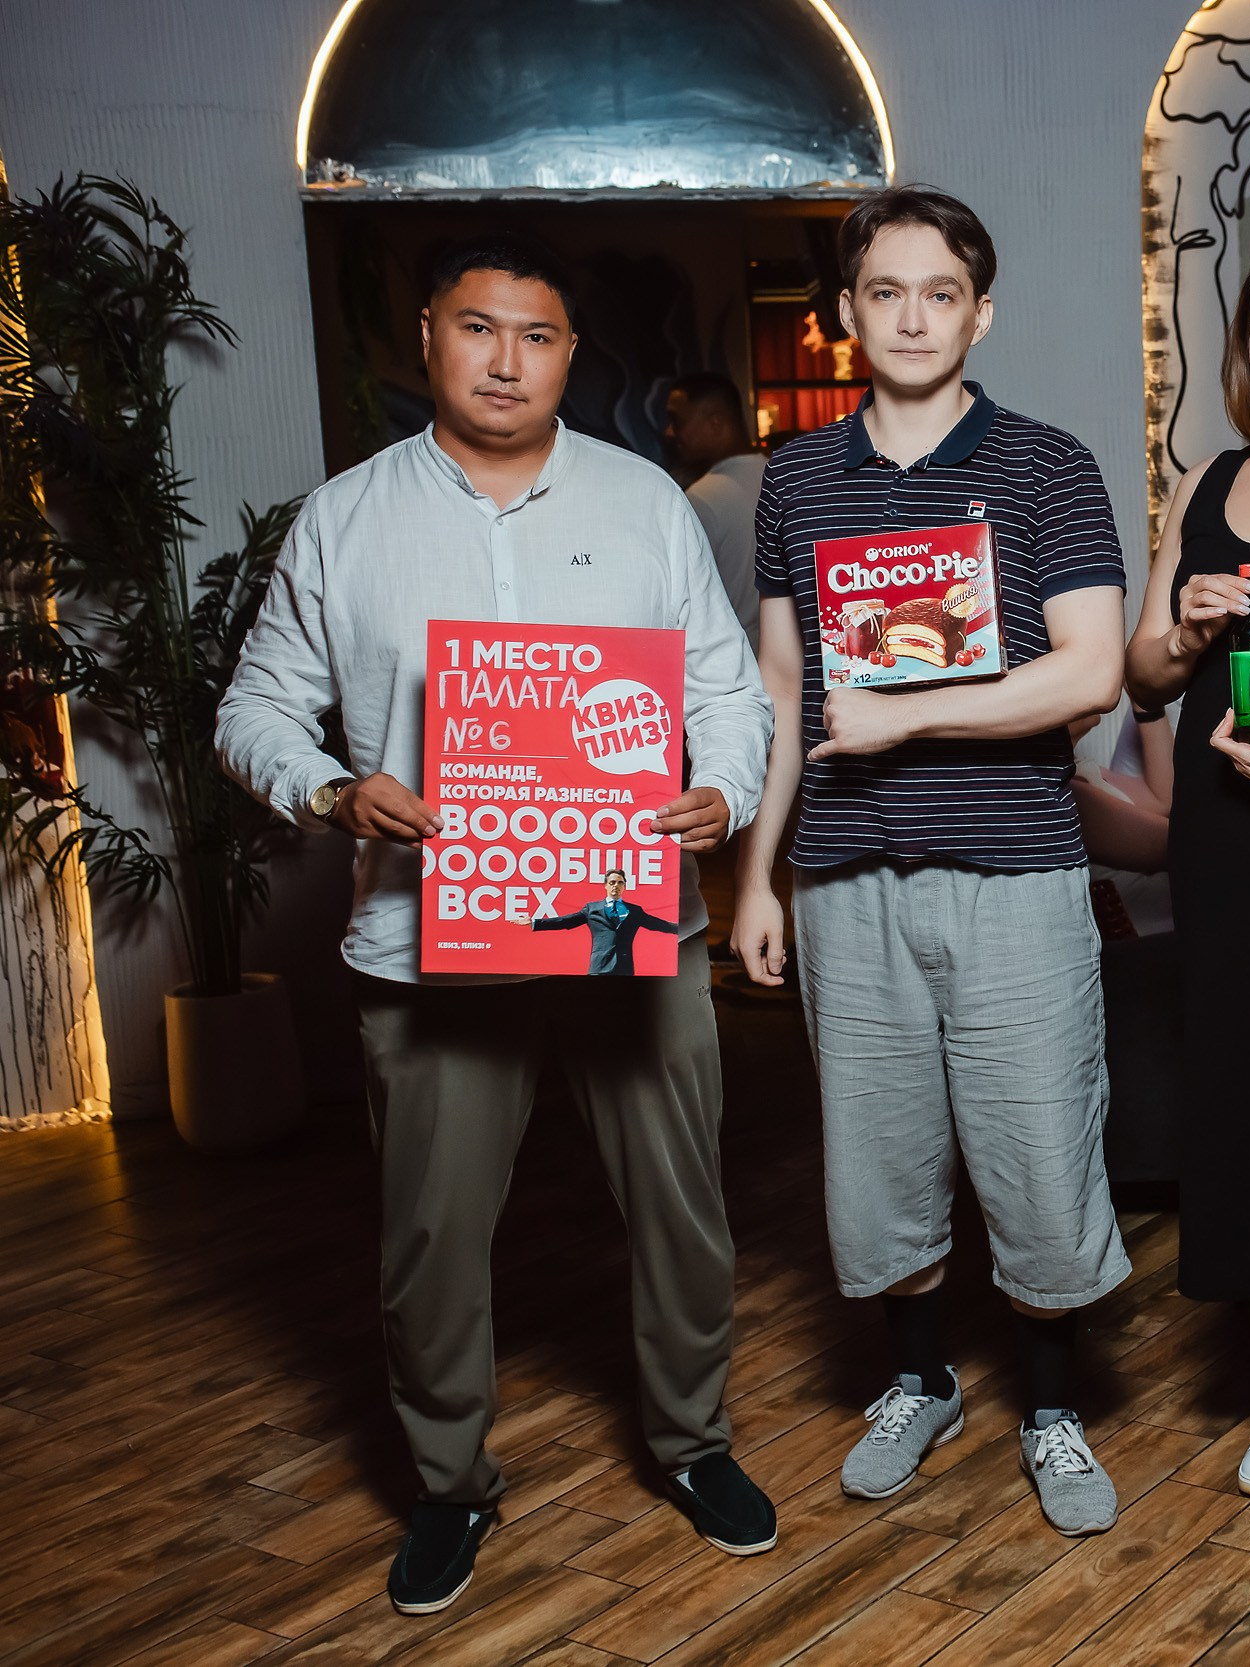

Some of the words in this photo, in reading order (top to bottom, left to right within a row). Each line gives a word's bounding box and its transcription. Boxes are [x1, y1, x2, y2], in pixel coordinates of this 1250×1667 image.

[882, 543, 930, 559] ORION
[446, 639, 460, 668] 1
[472, 640, 603, 673] МЕСТО
[438, 669, 581, 710] ПАЛАТА
[574, 692, 669, 733] КВИЗ,
[577, 718, 671, 760] ПЛИЗ!
[440, 763, 543, 783] КОМАНДЕ,
[440, 784, 530, 801] КОТОРАЯ
[534, 787, 634, 804] РАЗНЕСЛА
[438, 885, 562, 922] ВСЕХ
